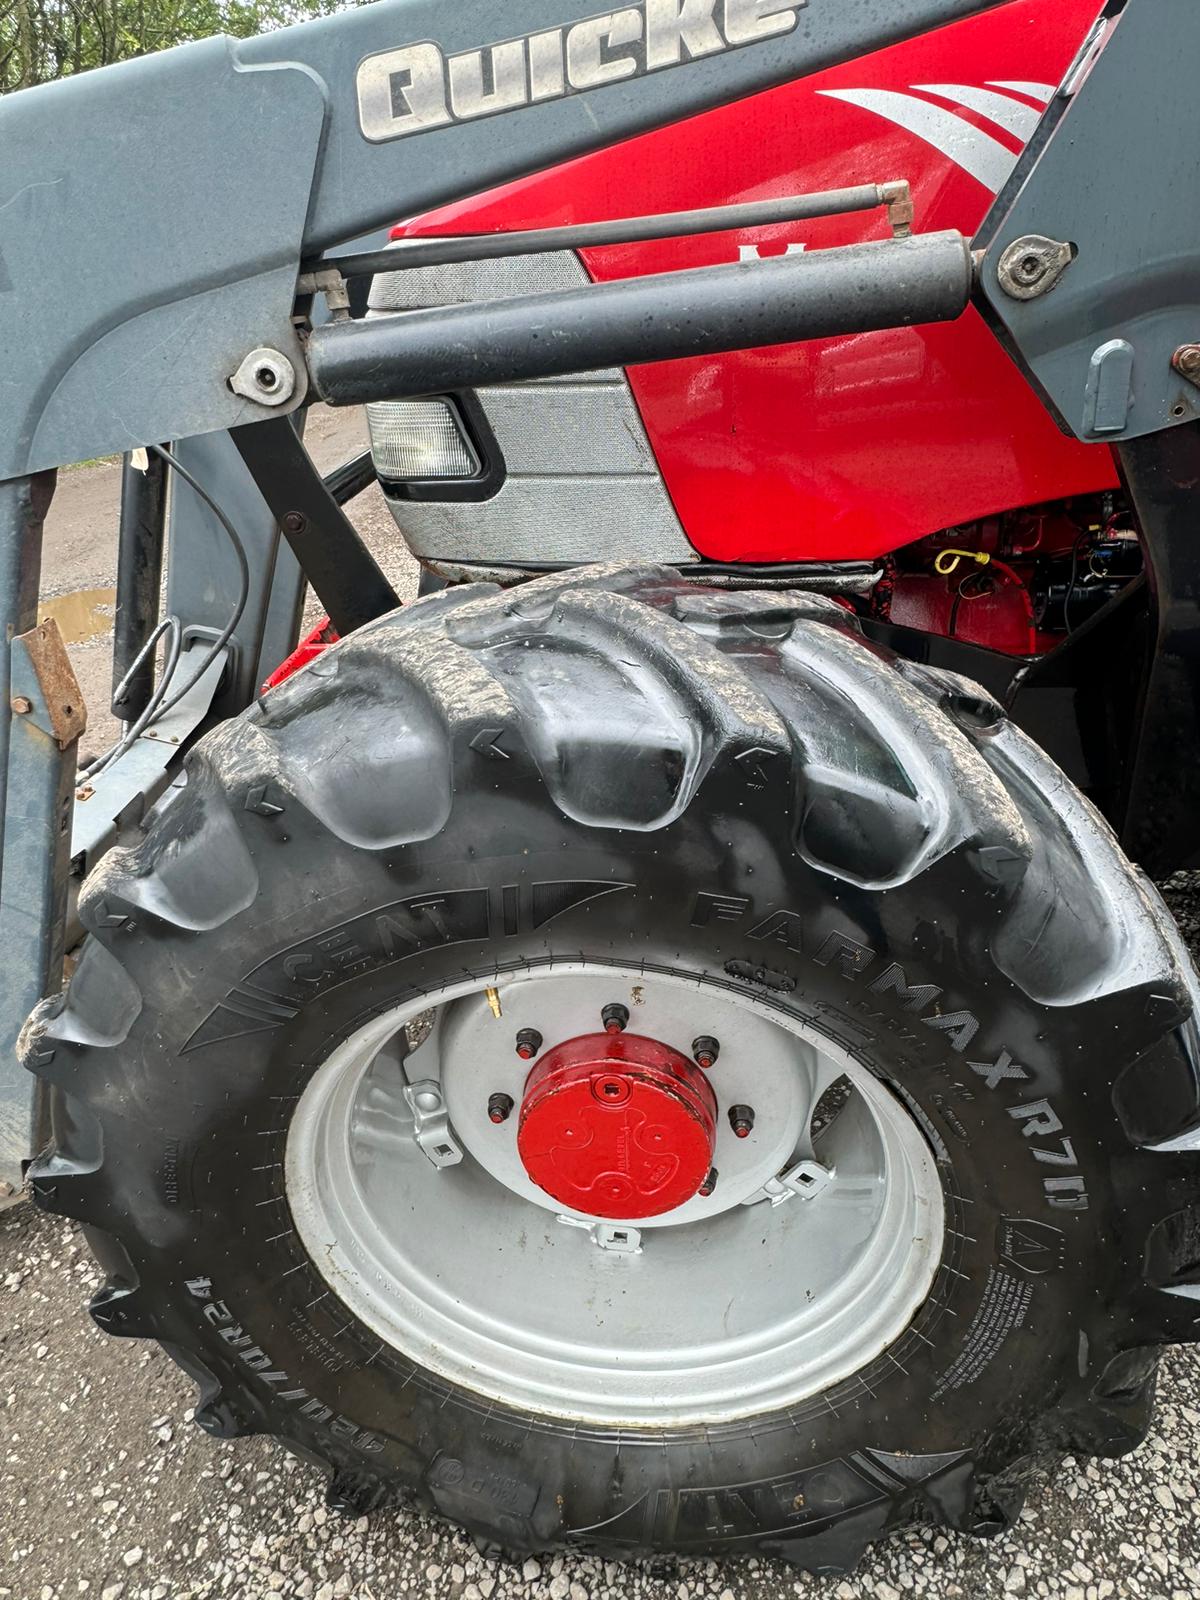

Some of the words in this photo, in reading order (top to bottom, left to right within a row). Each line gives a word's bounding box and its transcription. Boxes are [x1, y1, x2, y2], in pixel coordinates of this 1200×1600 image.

[690, 891, 1031, 1090] FARMAX
[1005, 1098, 1091, 1211] R70
[184, 1276, 385, 1453] 420/70R24
